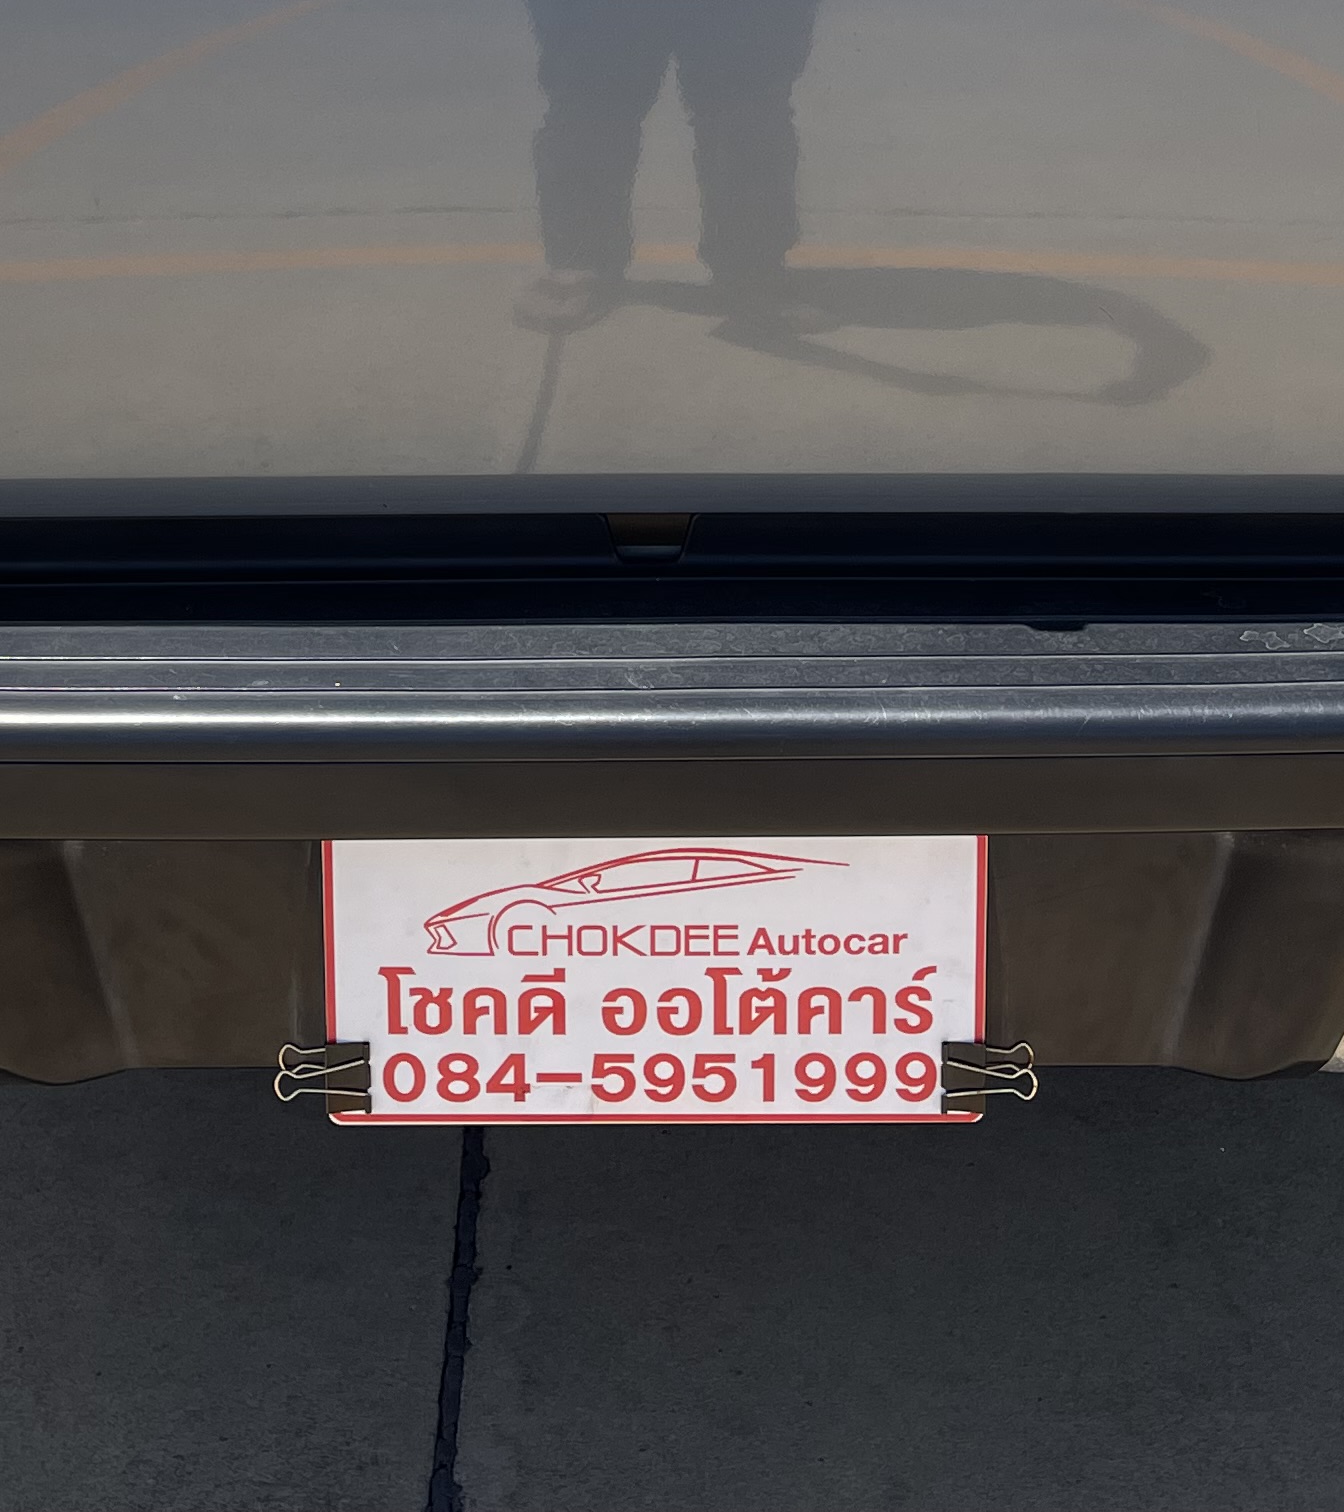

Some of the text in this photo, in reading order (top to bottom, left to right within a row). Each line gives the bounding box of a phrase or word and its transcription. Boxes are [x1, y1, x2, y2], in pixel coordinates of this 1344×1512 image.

[507, 925, 909, 956] CHOKDEE Autocar
[377, 965, 937, 1036] โชคดี ออโต้คาร์
[382, 1052, 939, 1103] 084-5951999
